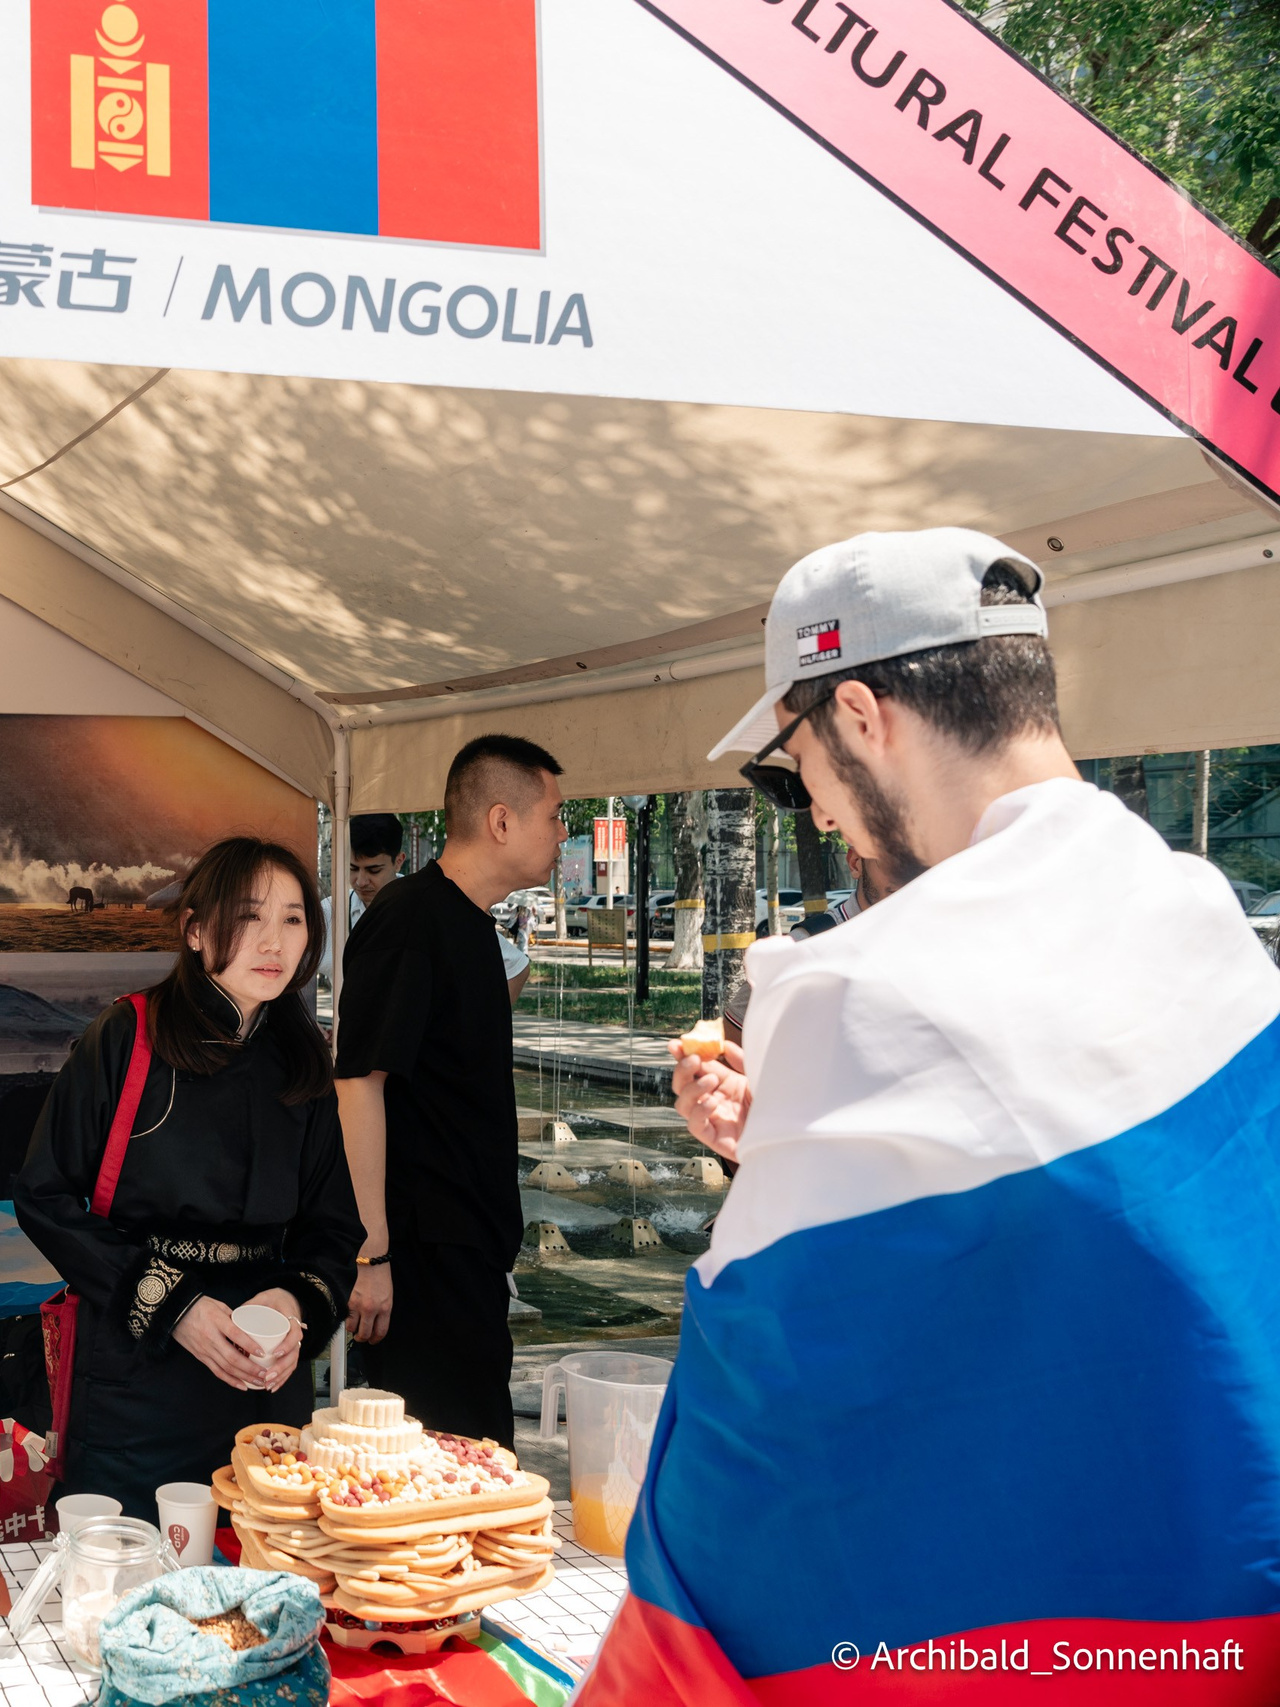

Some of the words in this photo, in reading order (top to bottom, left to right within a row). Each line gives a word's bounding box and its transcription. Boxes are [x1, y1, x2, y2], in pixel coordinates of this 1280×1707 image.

[762, 0, 1007, 191] LTURAL
[1019, 167, 1264, 395] FESTIVAL
[200, 263, 594, 348] MONGOLIA
[797, 620, 837, 639] TOMMY
